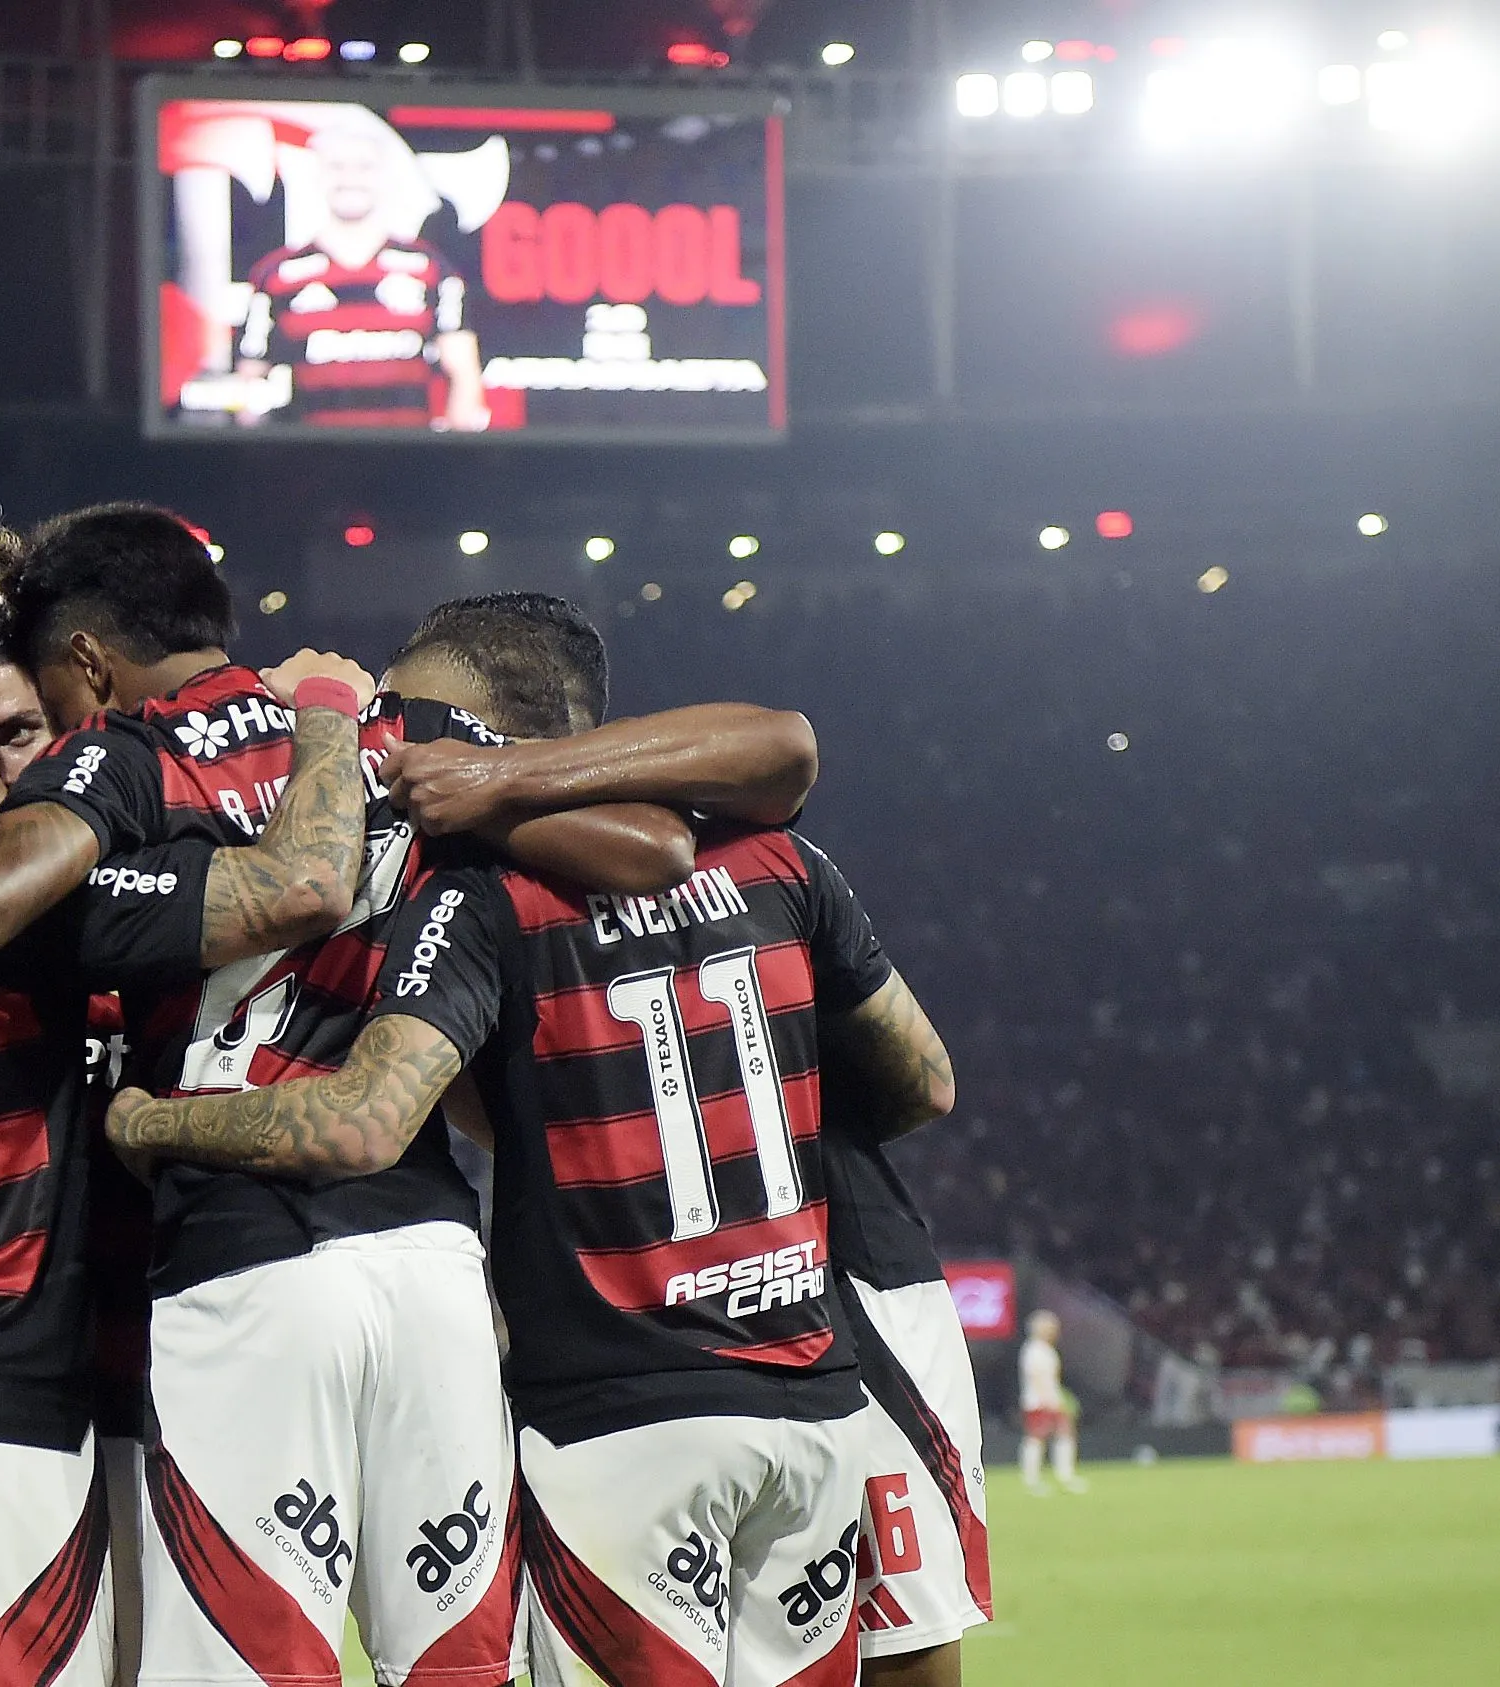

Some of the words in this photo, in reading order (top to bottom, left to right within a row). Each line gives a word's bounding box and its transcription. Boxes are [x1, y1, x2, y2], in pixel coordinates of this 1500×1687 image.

[481, 200, 761, 306] GOOOL
[88, 867, 178, 897] opee
[396, 888, 465, 998] Shopee
[650, 998, 673, 1074] TEXACO
[734, 978, 758, 1053] TEXACO
[606, 945, 803, 1243] 11
[665, 1239, 818, 1307] ASSIST
[726, 1267, 825, 1320] CARD
[255, 1515, 275, 1537] da
[275, 1534, 334, 1605] construção
[274, 1478, 353, 1589] abc
[405, 1480, 491, 1593] abc
[436, 1592, 456, 1612] da
[455, 1516, 498, 1595] construção
[648, 1571, 668, 1592] da
[667, 1588, 723, 1652] construção
[802, 1625, 823, 1644] da
